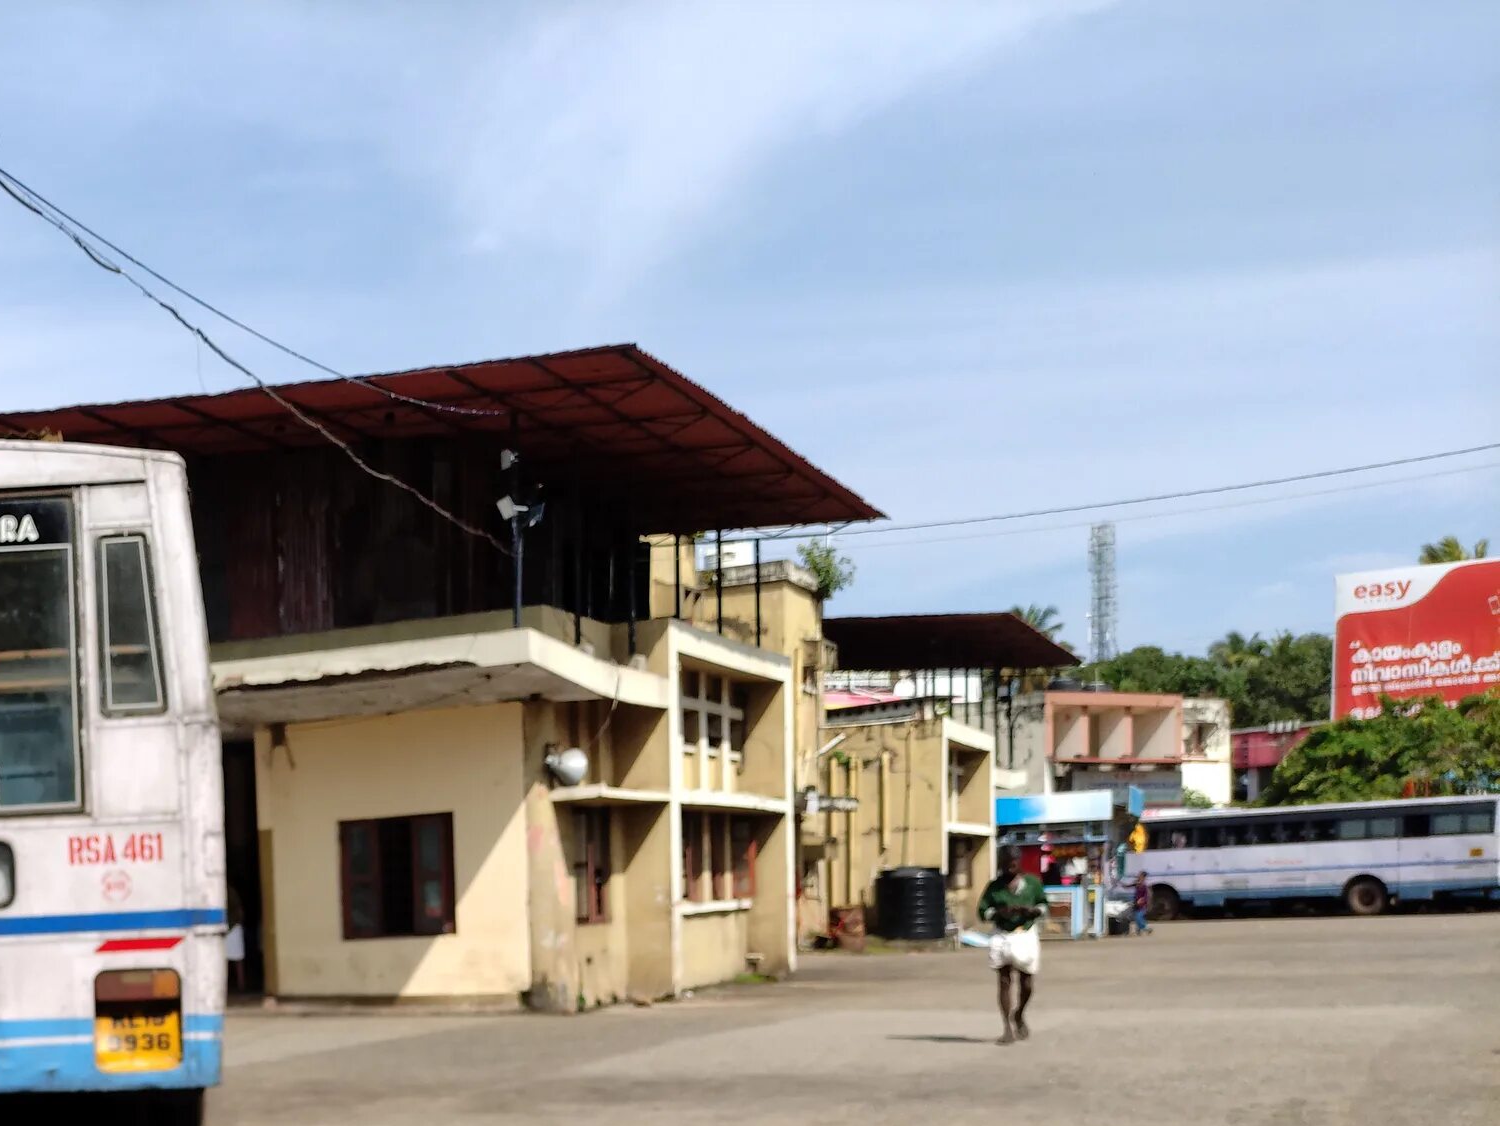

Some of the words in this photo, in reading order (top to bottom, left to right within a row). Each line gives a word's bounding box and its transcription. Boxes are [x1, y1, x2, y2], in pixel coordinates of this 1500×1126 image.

[1353, 579, 1412, 600] easy
[68, 835, 116, 865] RSA
[123, 833, 164, 862] 461
